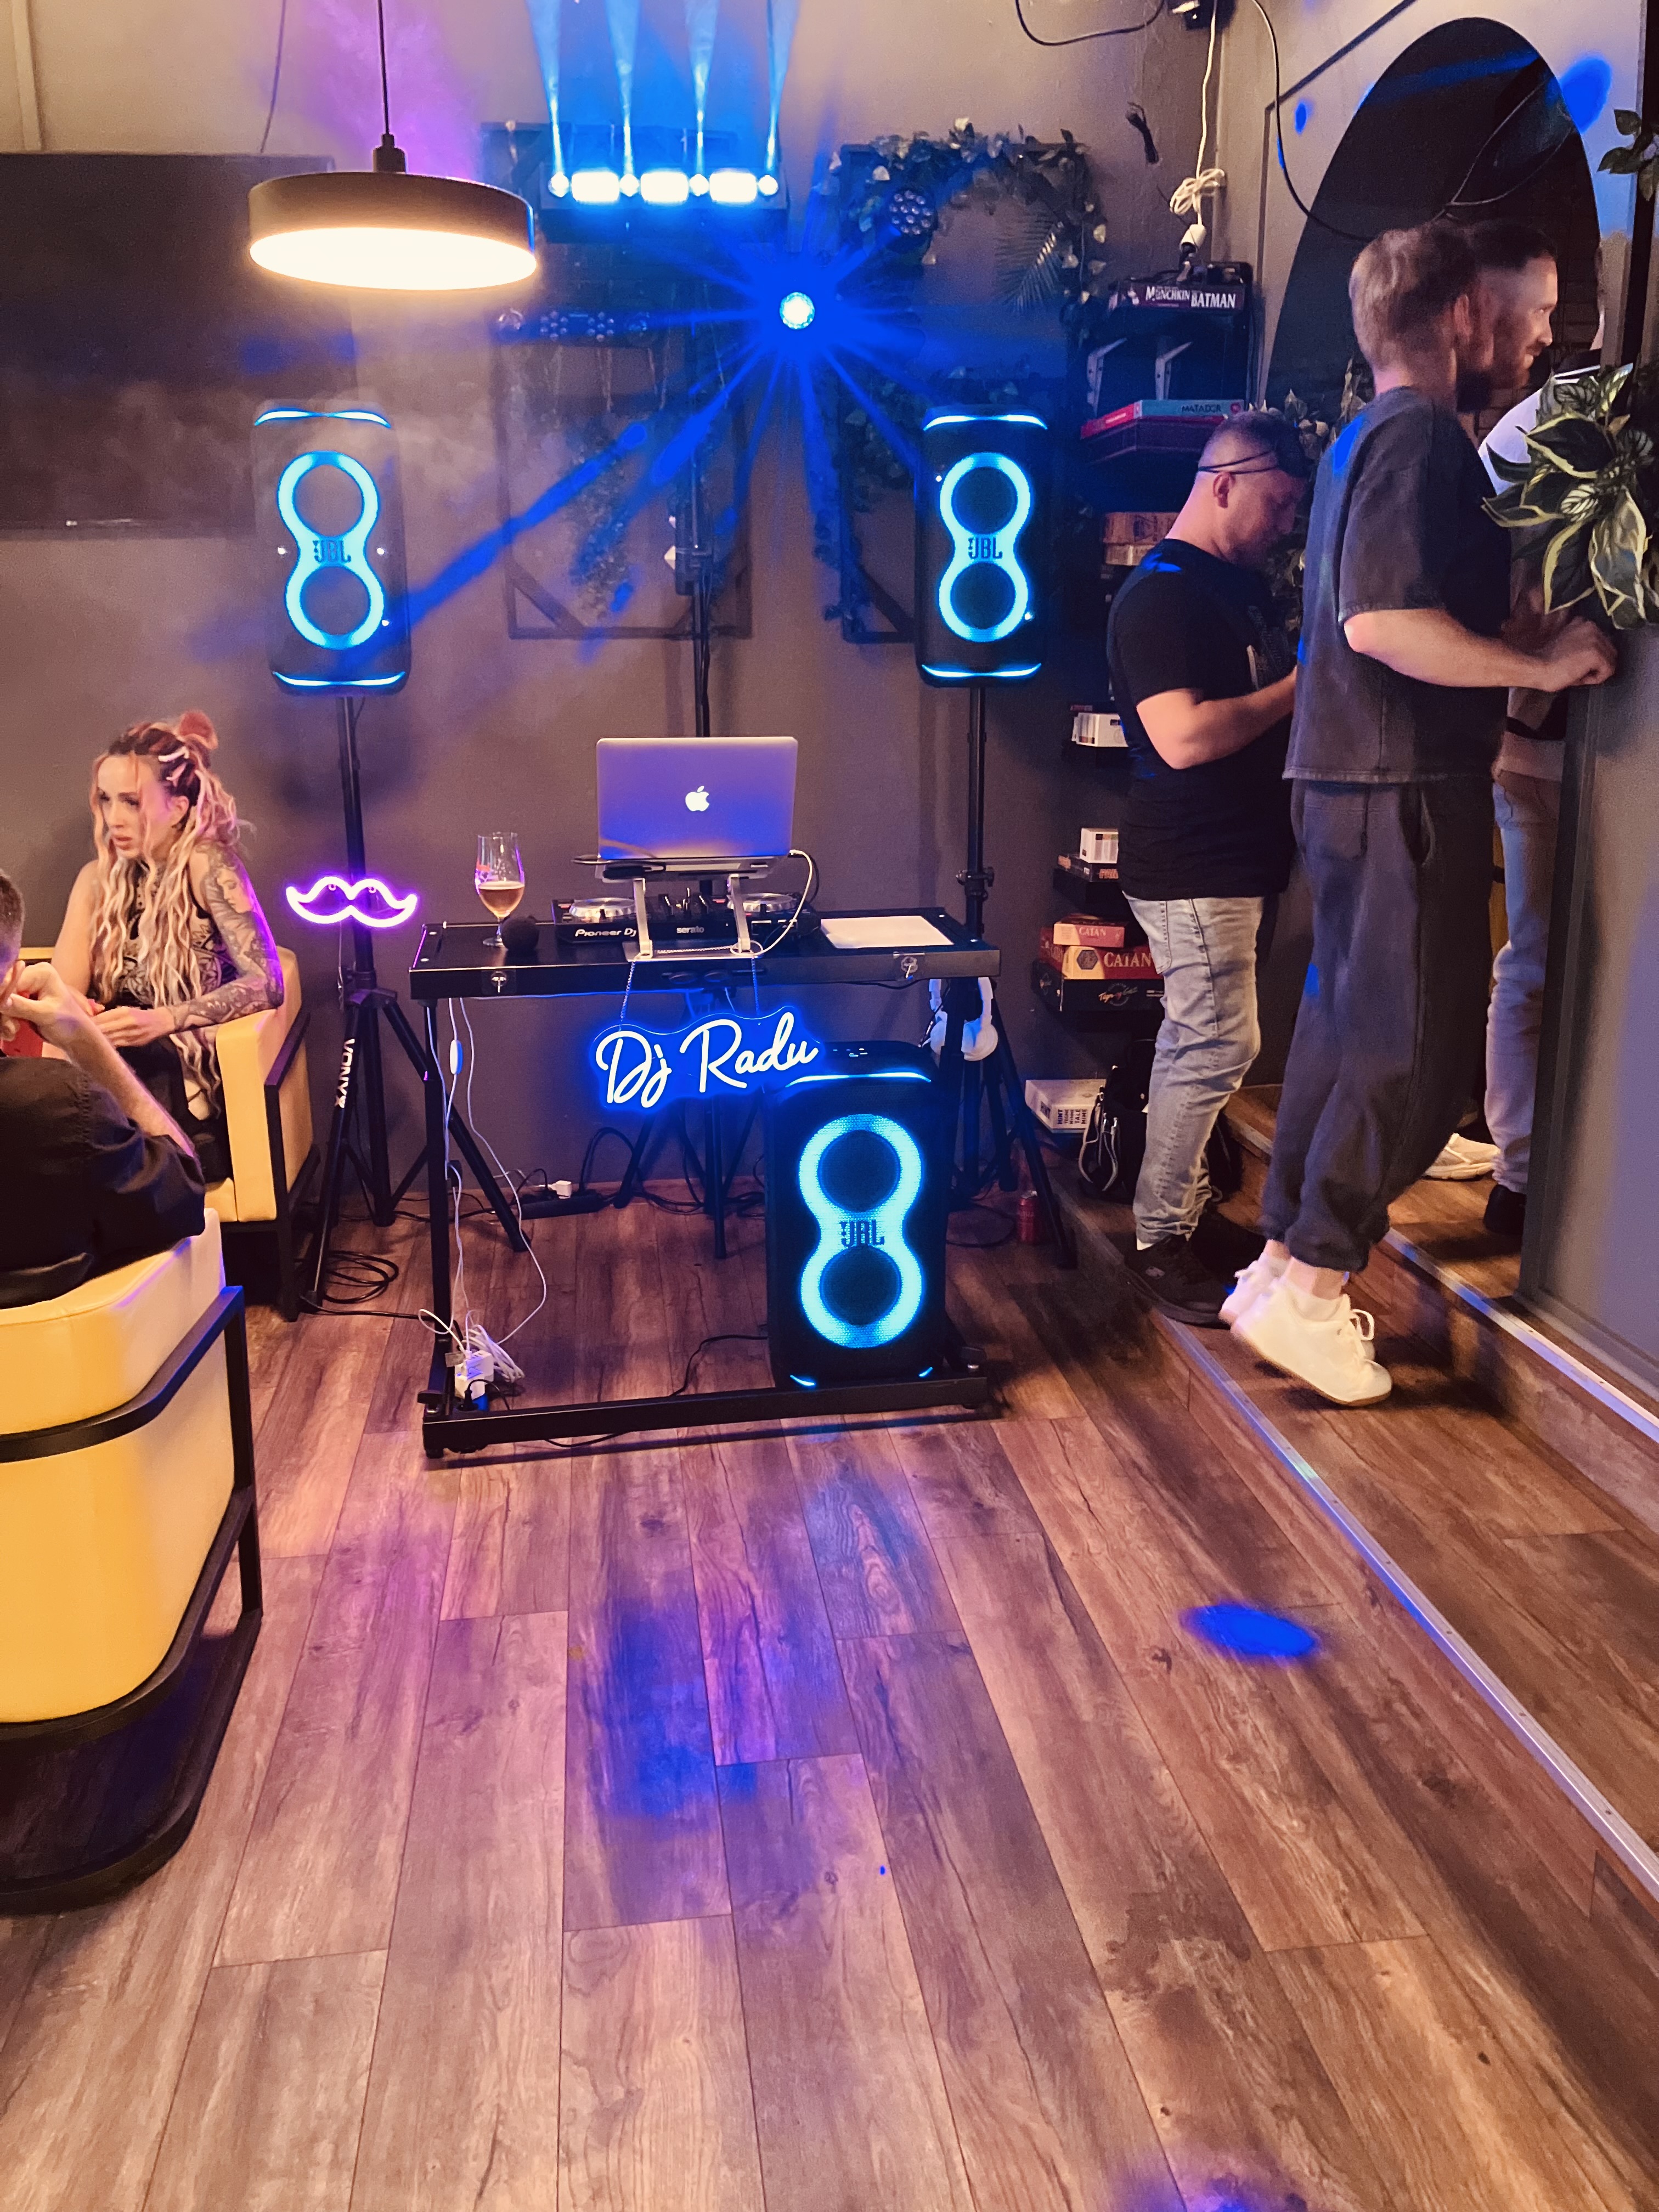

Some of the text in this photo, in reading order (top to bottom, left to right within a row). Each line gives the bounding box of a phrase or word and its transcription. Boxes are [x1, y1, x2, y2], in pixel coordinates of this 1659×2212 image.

[1191, 292, 1235, 308] BATMAN
[313, 540, 352, 563] JBL
[968, 537, 1003, 559] JBL
[1079, 927, 1107, 937] CATAN
[1103, 952, 1152, 967] CATAN
[679, 1012, 819, 1093] Radu
[335, 1039, 355, 1108] VONYX
[840, 1221, 885, 1248] JBL
